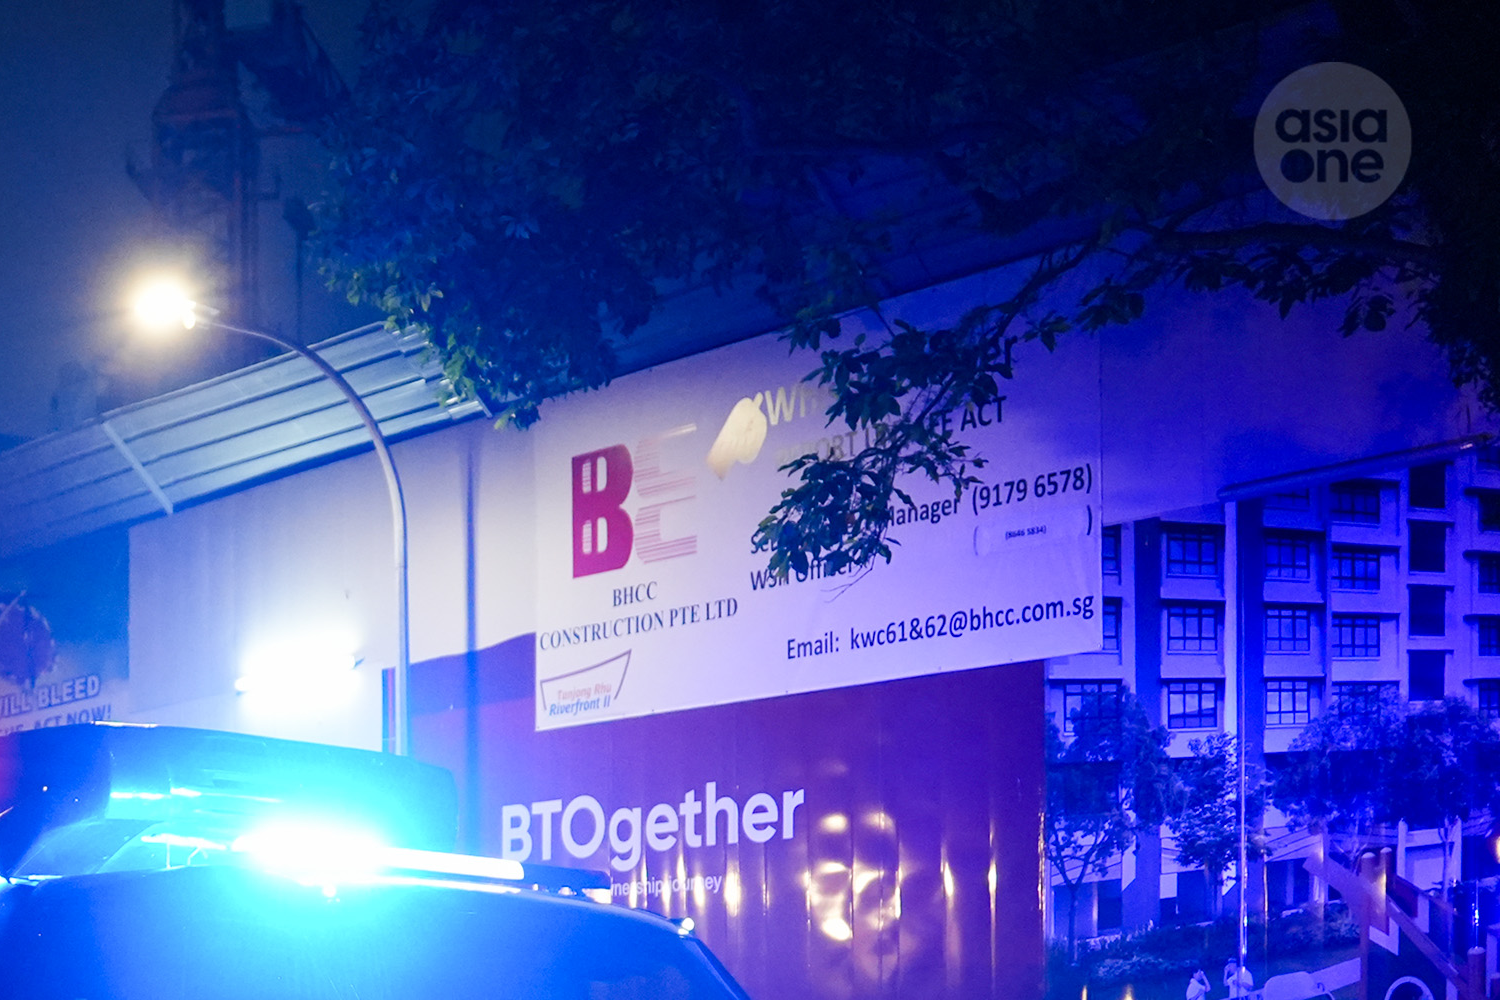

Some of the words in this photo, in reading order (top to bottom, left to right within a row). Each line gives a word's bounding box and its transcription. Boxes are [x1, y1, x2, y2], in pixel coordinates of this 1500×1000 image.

[972, 478, 1028, 515] (9179
[1034, 463, 1092, 498] 6578)
[612, 581, 658, 607] BHCC
[539, 610, 665, 651] CONSTRUCTION
[669, 604, 701, 628] PTE
[705, 597, 738, 621] LTD
[787, 631, 840, 660] Email:
[850, 595, 1095, 650] kwc61&62@bhcc.com.sg
[37, 674, 100, 708] BLEED
[549, 698, 601, 717] Riverfront
[501, 781, 805, 872] BTOgether
